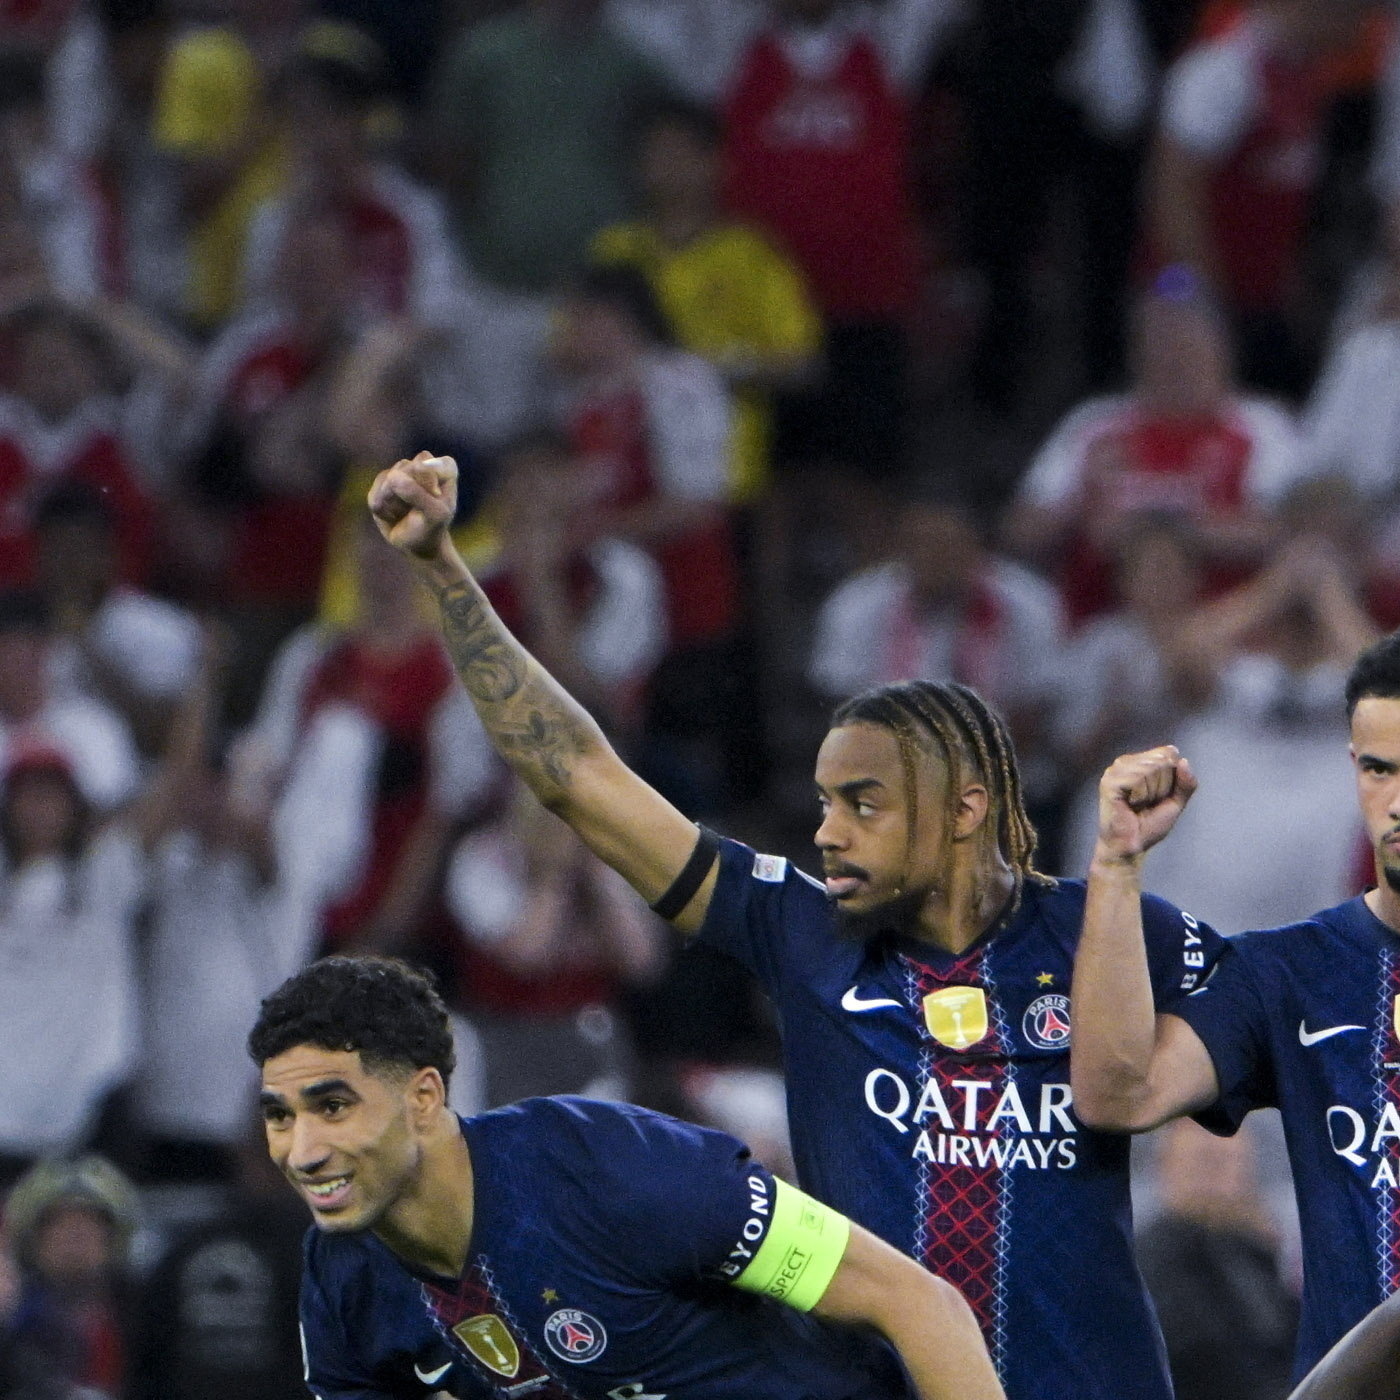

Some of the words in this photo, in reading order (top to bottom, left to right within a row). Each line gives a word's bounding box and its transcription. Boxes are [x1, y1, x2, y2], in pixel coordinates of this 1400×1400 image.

[1029, 996, 1067, 1017] PARIS
[864, 1067, 1078, 1134] QATAR
[911, 1130, 1077, 1170] AIRWAYS
[716, 1175, 769, 1277] EYOND
